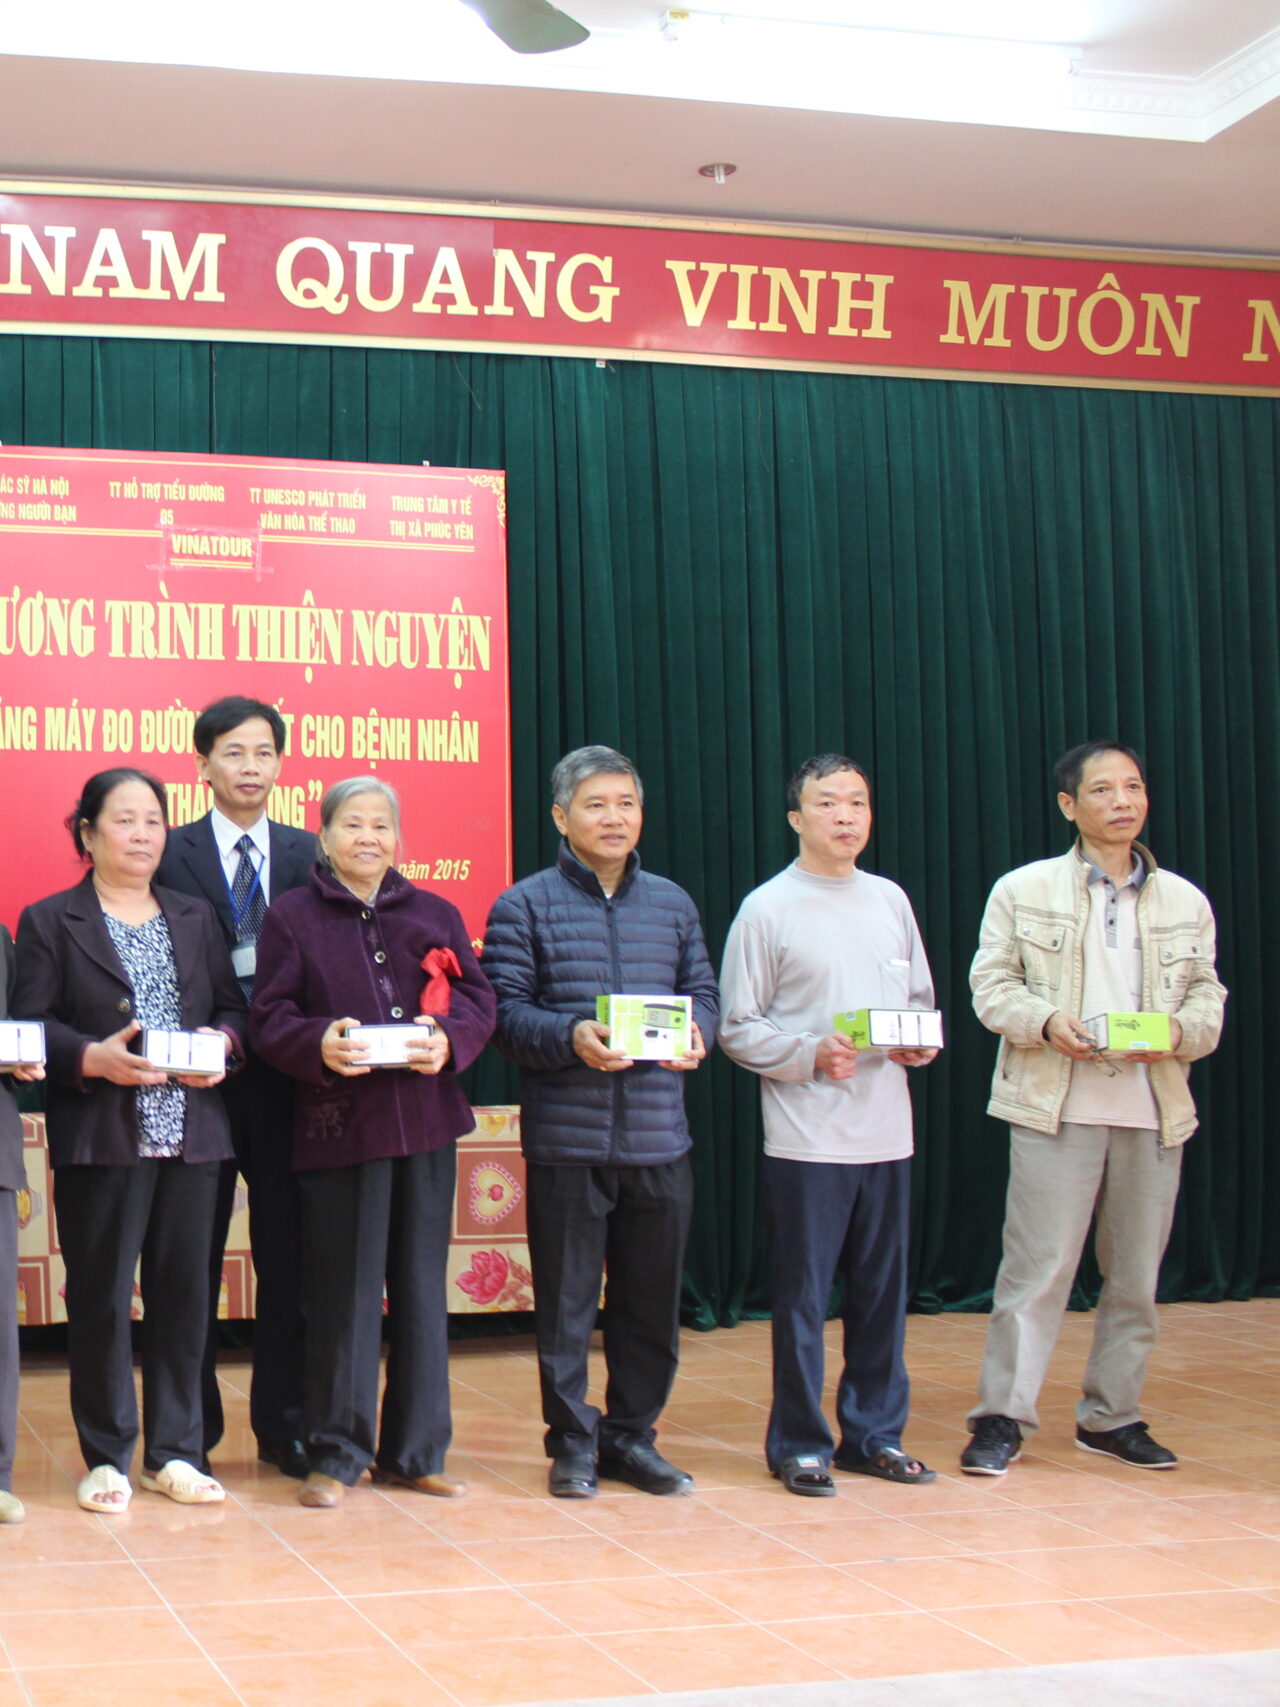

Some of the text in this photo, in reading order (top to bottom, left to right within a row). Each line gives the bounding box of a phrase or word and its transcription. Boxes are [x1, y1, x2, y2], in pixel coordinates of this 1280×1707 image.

[0, 223, 227, 302] NAM
[275, 236, 620, 323] QUANG
[666, 259, 894, 339] VINH
[939, 272, 1200, 358] MUÔN
[109, 481, 121, 498] TT
[249, 487, 261, 504] TT
[263, 488, 306, 506] UNESCO
[308, 488, 335, 508] PHÁT
[391, 495, 425, 513] TRUNG
[450, 498, 458, 515] Y
[329, 517, 356, 534] THAO
[171, 533, 253, 557] VINATOUR
[105, 580, 225, 660] TRÌNH
[232, 589, 343, 684] THIỆN
[351, 597, 492, 690] NGUYỆN
[44, 698, 96, 752] MÁY
[102, 708, 134, 753] ĐO
[301, 713, 345, 759] CHO
[351, 707, 411, 770] BỆNH
[417, 710, 479, 763] NHÂN
[432, 858, 471, 881] 2015
